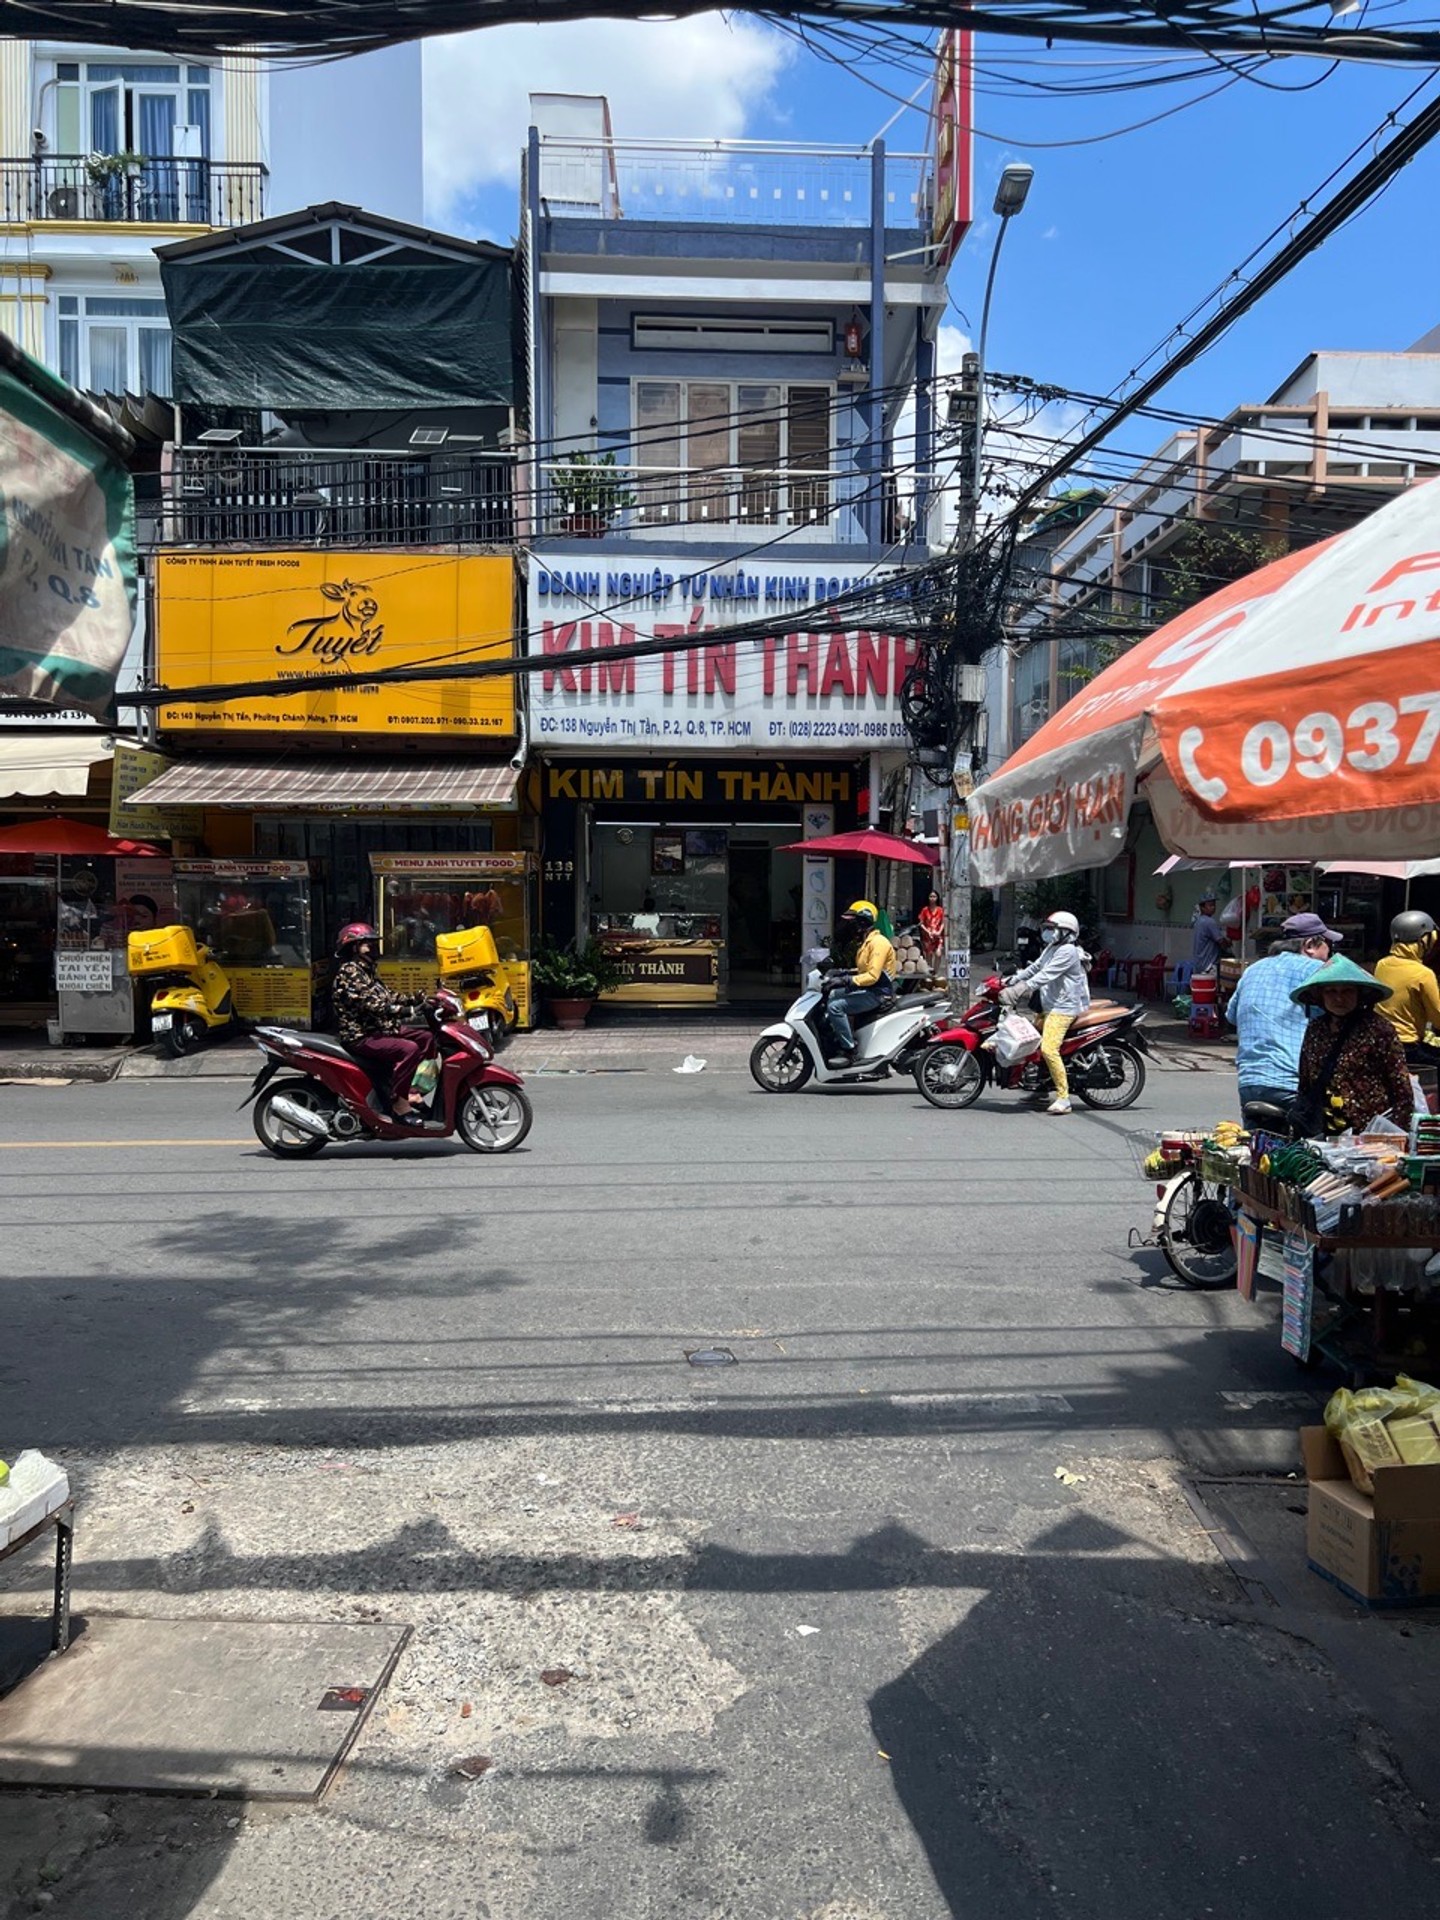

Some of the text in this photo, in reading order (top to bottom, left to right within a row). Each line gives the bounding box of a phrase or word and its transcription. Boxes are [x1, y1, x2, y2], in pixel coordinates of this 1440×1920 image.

[166, 557, 187, 566] CÔNG
[199, 558, 217, 566] TNHH
[256, 559, 275, 567] FRESH
[277, 560, 300, 568] FOODS
[538, 570, 600, 597] DOANH
[606, 567, 674, 602] NGHIỆP
[710, 568, 759, 600] NHÂN
[765, 575, 809, 600] KINH
[276, 610, 384, 664] Tuyết
[543, 621, 636, 693] KIM
[654, 606, 736, 694] TÍN
[541, 717, 558, 733] ĐC:
[560, 718, 576, 733] 138
[580, 717, 617, 736] Nguyễn
[621, 719, 636, 736] Thị
[769, 721, 785, 737] ĐT:
[1241, 692, 1440, 787] 0937
[550, 761, 850, 801] KIM TÍN THÀNH
[1028, 775, 1071, 839] GIỚI
[1074, 772, 1125, 841] HẠN
[237, 864, 264, 872] TUYET
[545, 861, 573, 871] 138
[639, 960, 685, 975] THÀNH
